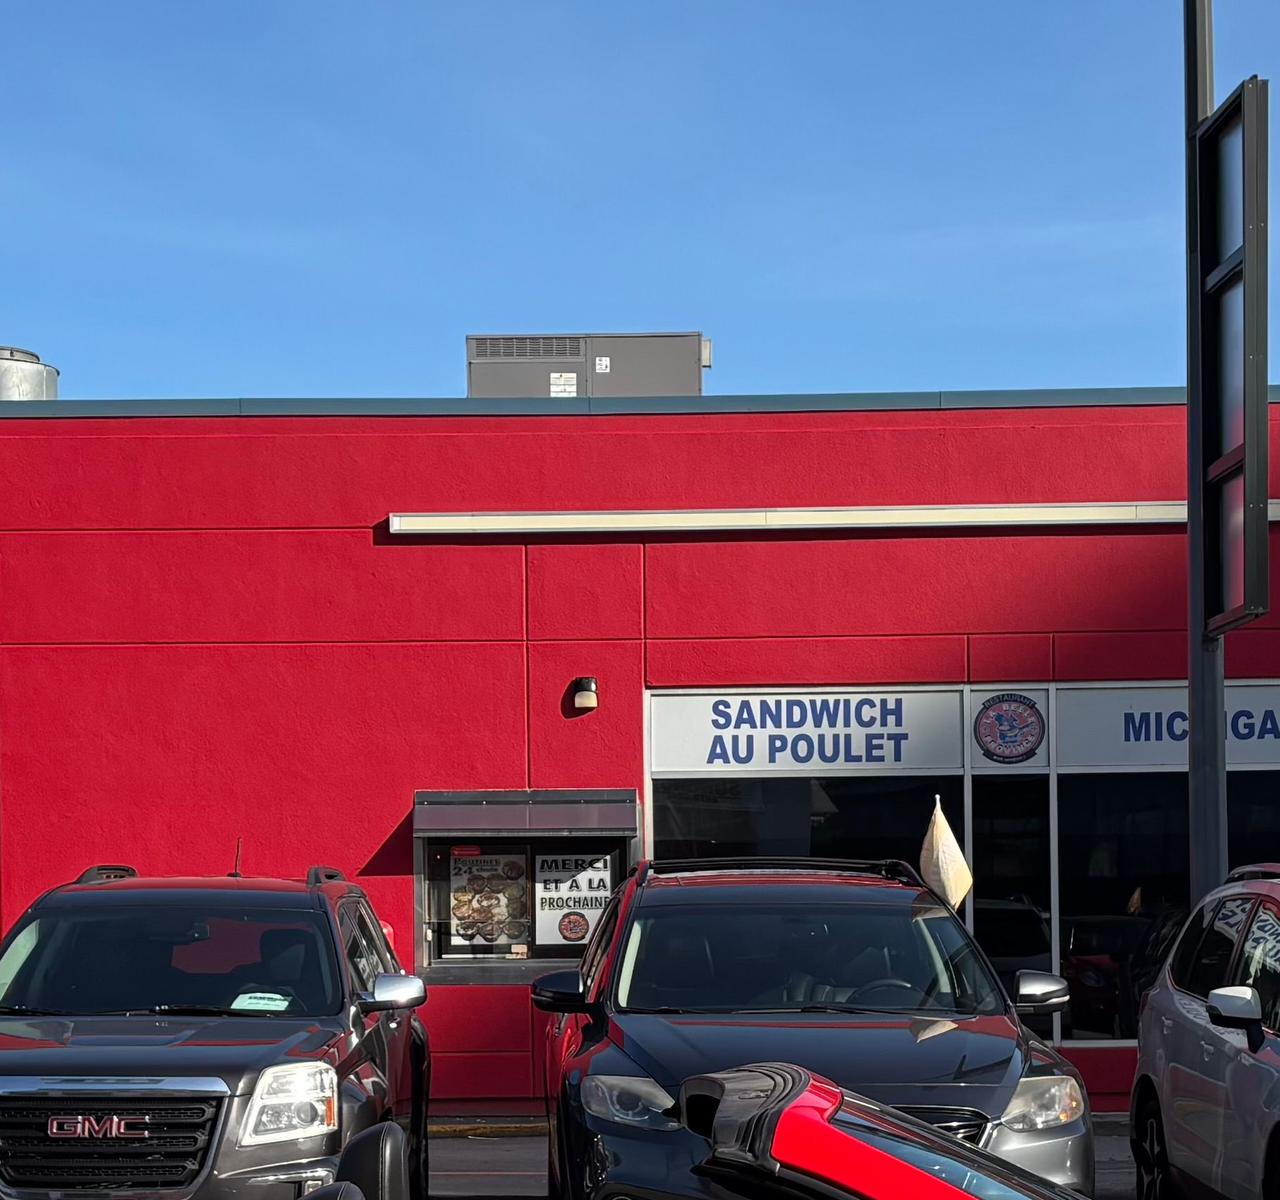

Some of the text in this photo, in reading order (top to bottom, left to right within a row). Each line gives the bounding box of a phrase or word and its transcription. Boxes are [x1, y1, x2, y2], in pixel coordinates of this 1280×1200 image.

[711, 698, 903, 730] SANDWICH
[706, 733, 909, 764] AU POULET
[539, 858, 609, 873] MERCI
[543, 878, 562, 892] ET
[588, 878, 609, 892] LA
[48, 1115, 150, 1138] GMC
